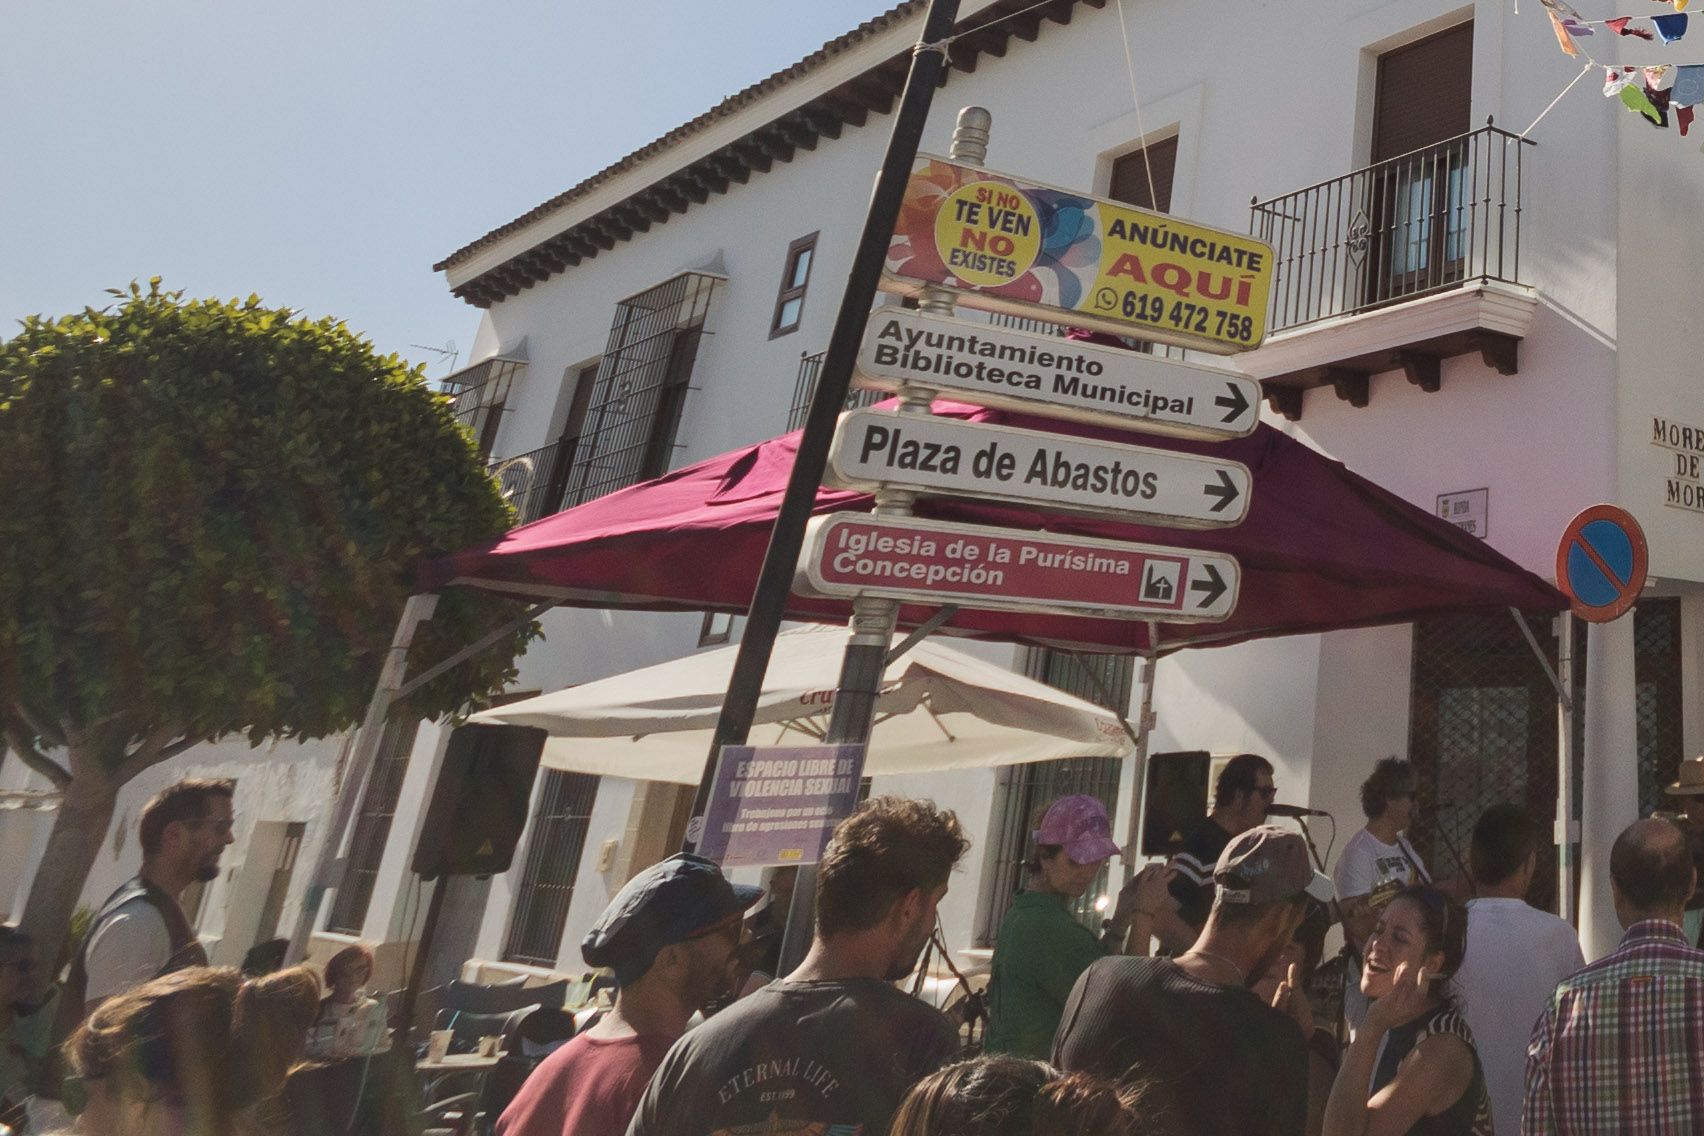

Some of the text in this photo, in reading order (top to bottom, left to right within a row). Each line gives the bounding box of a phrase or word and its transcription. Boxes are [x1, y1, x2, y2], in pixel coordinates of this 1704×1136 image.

[955, 199, 1031, 237] TE VEN
[976, 187, 1020, 210] SI NO
[950, 248, 1017, 278] EXISTES
[959, 228, 1016, 257] NO
[1108, 218, 1263, 272] ANÚNCIATE
[1106, 253, 1257, 307] AQUÍ
[1122, 291, 1253, 342] 619 472 758
[878, 320, 1104, 377] Ayuntamiento
[874, 344, 1194, 416] Biblioteca Municipal
[859, 425, 1158, 500] Plaza de Abastos
[1676, 454, 1700, 478] DE
[833, 552, 1004, 587] Concepción
[838, 528, 1130, 574] Iglesia de la Purísima
[729, 777, 850, 798] VIOLENCIA SEXUAL
[736, 759, 854, 778] ESPACIO LIBRE DE
[718, 1057, 840, 1104] ETERNAL LIFE
